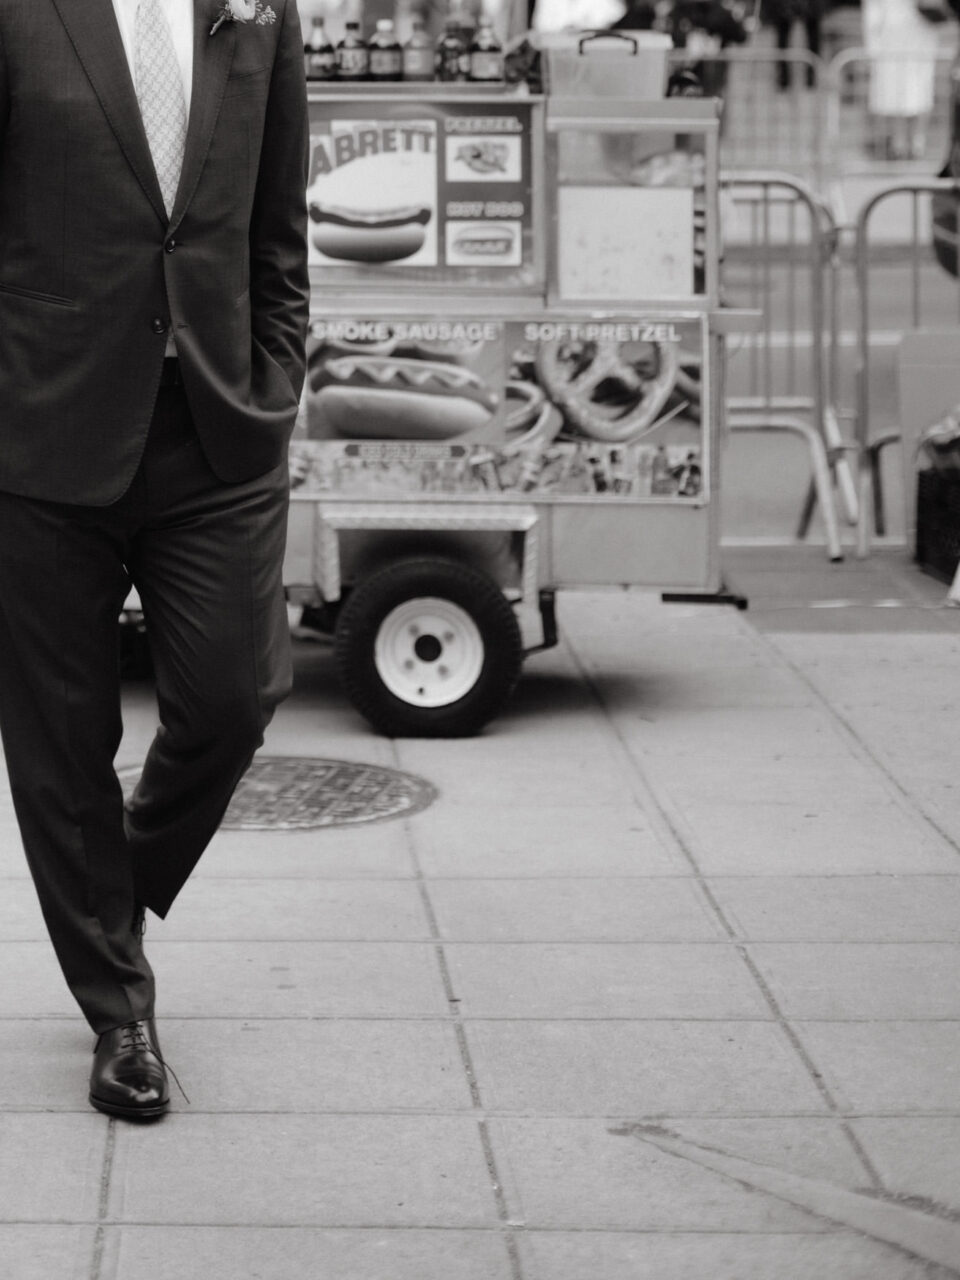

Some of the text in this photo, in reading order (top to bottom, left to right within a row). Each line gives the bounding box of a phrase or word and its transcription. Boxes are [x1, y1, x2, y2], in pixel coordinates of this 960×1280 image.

[308, 128, 434, 188] ABRETT
[313, 322, 497, 342] SMOKE SAUSAGE
[524, 323, 683, 343] SOFT PRETZEL
